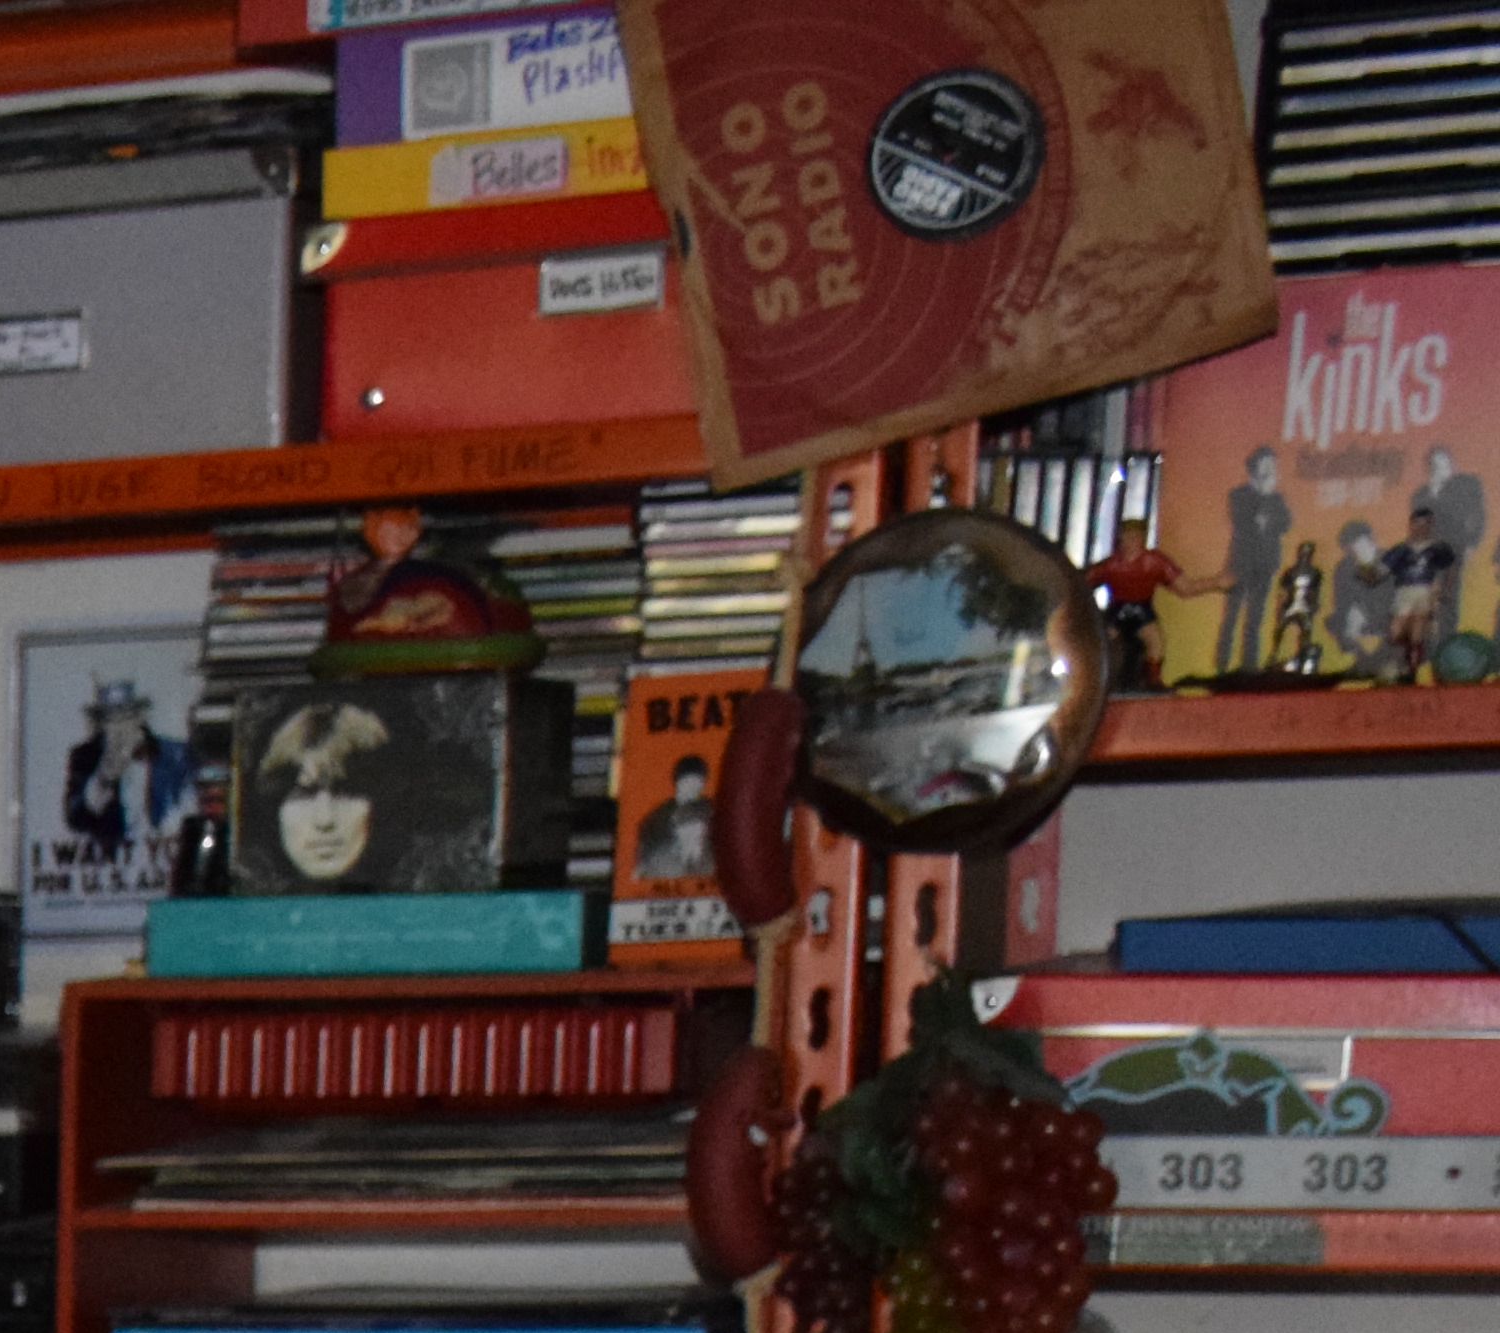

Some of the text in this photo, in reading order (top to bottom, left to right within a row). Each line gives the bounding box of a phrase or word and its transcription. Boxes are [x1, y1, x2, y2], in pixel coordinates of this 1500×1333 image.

[720, 101, 800, 326] SONO
[781, 80, 864, 308] RADIO
[1282, 311, 1448, 443] kinks
[647, 692, 746, 734] BEAT
[48, 838, 140, 872] WANT
[1158, 1153, 1389, 1193] 303 303
